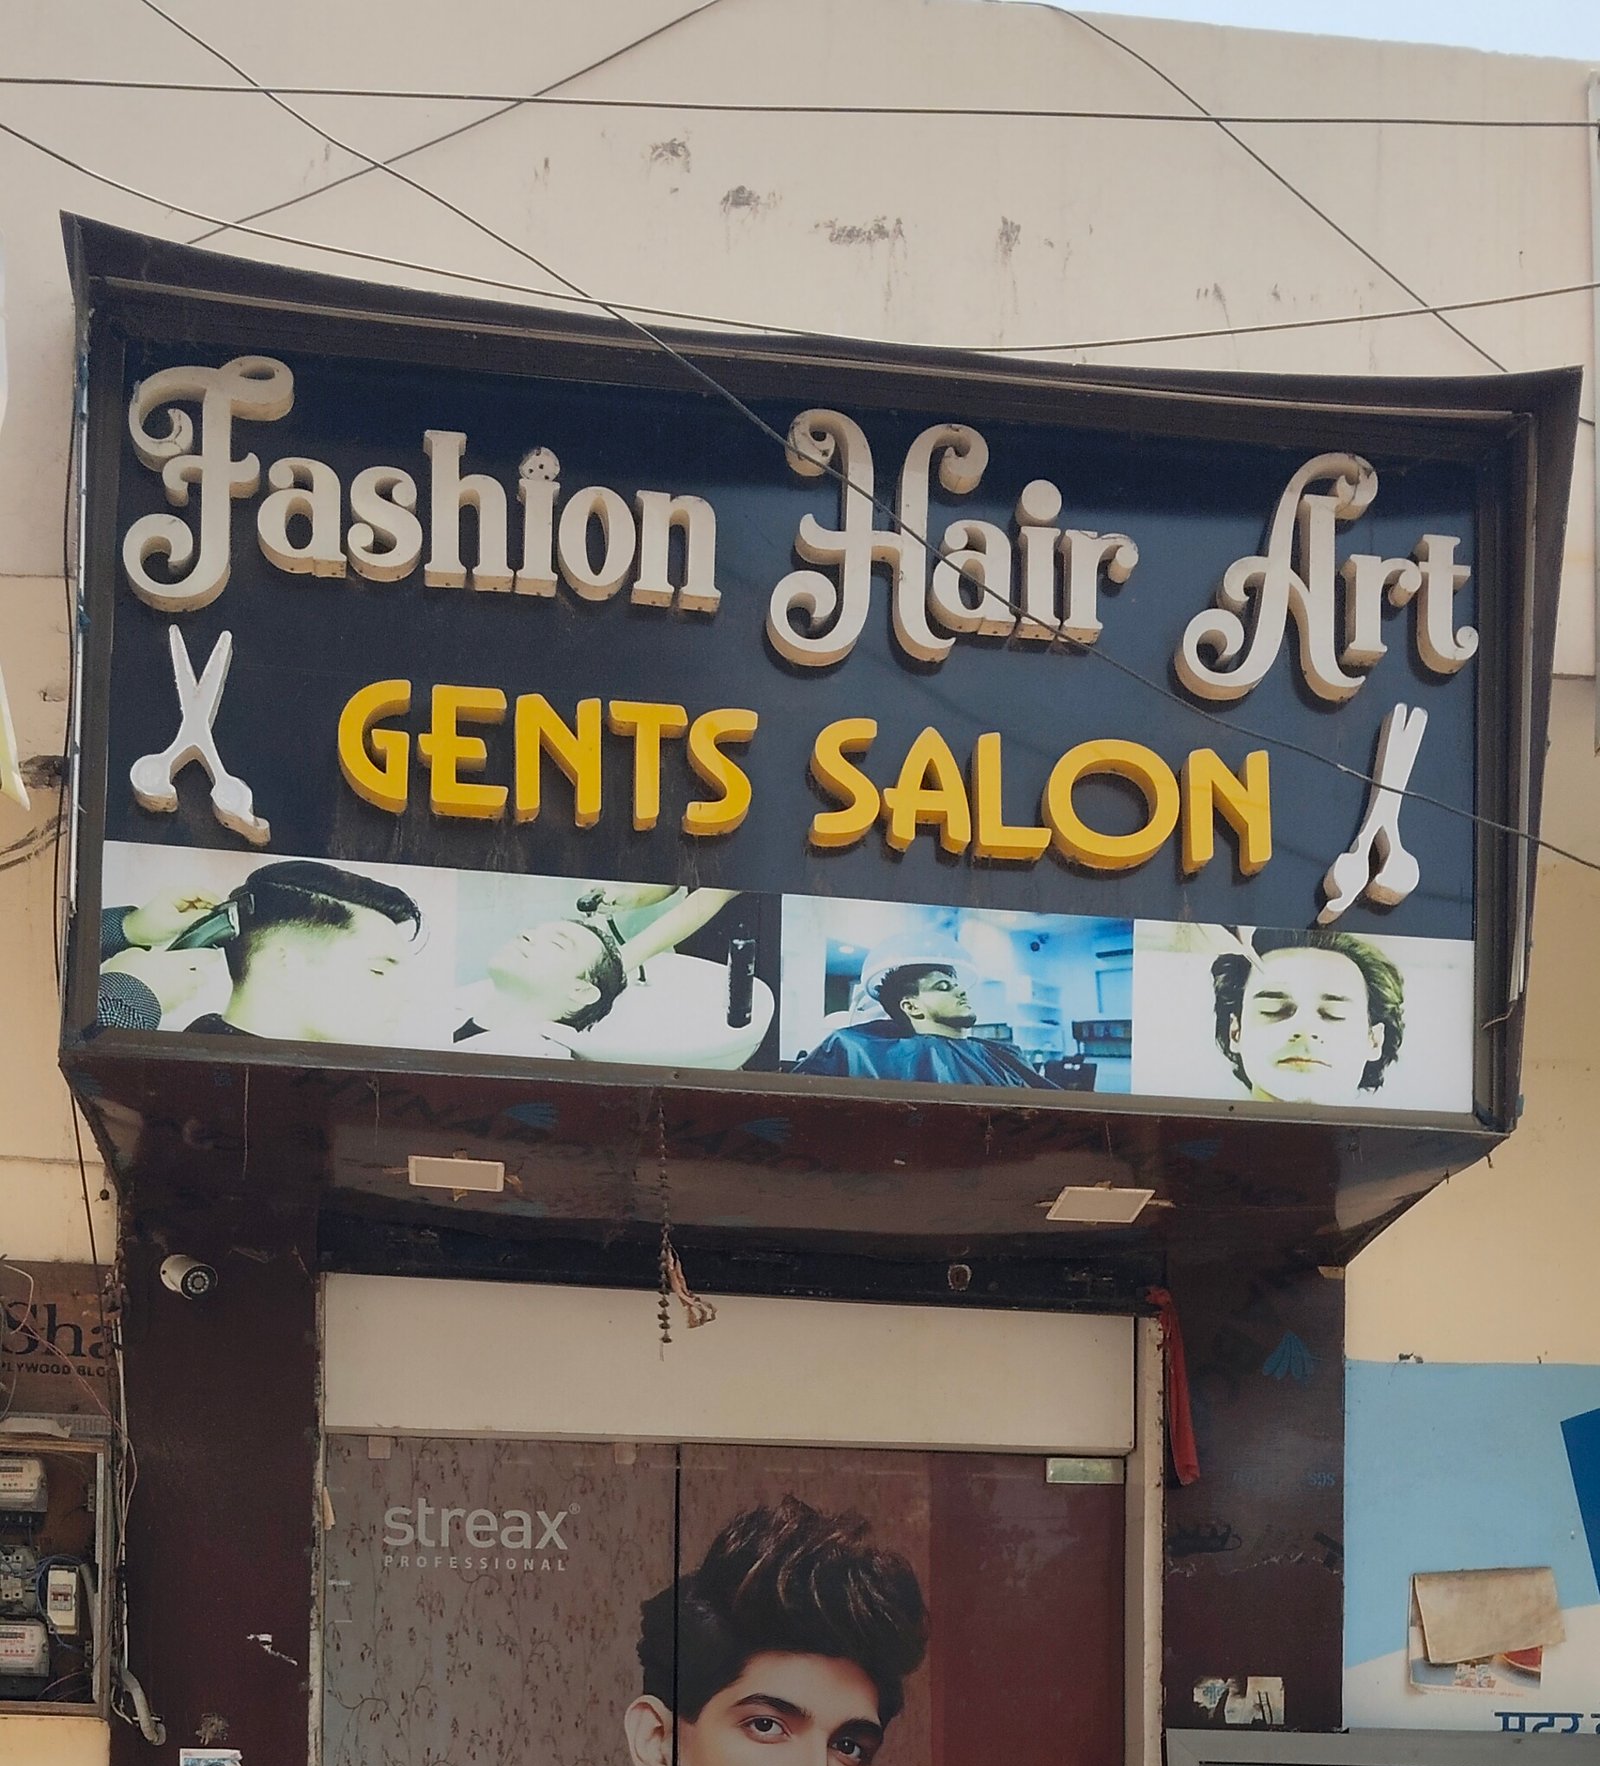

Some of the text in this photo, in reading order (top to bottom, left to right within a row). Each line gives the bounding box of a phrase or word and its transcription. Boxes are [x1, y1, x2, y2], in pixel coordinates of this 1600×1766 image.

[123, 355, 1480, 702] Fashion Hair Art
[337, 679, 1272, 877] GENTS SALON
[382, 1497, 569, 1550] streax
[384, 1555, 566, 1571] PROFESSIONAL
